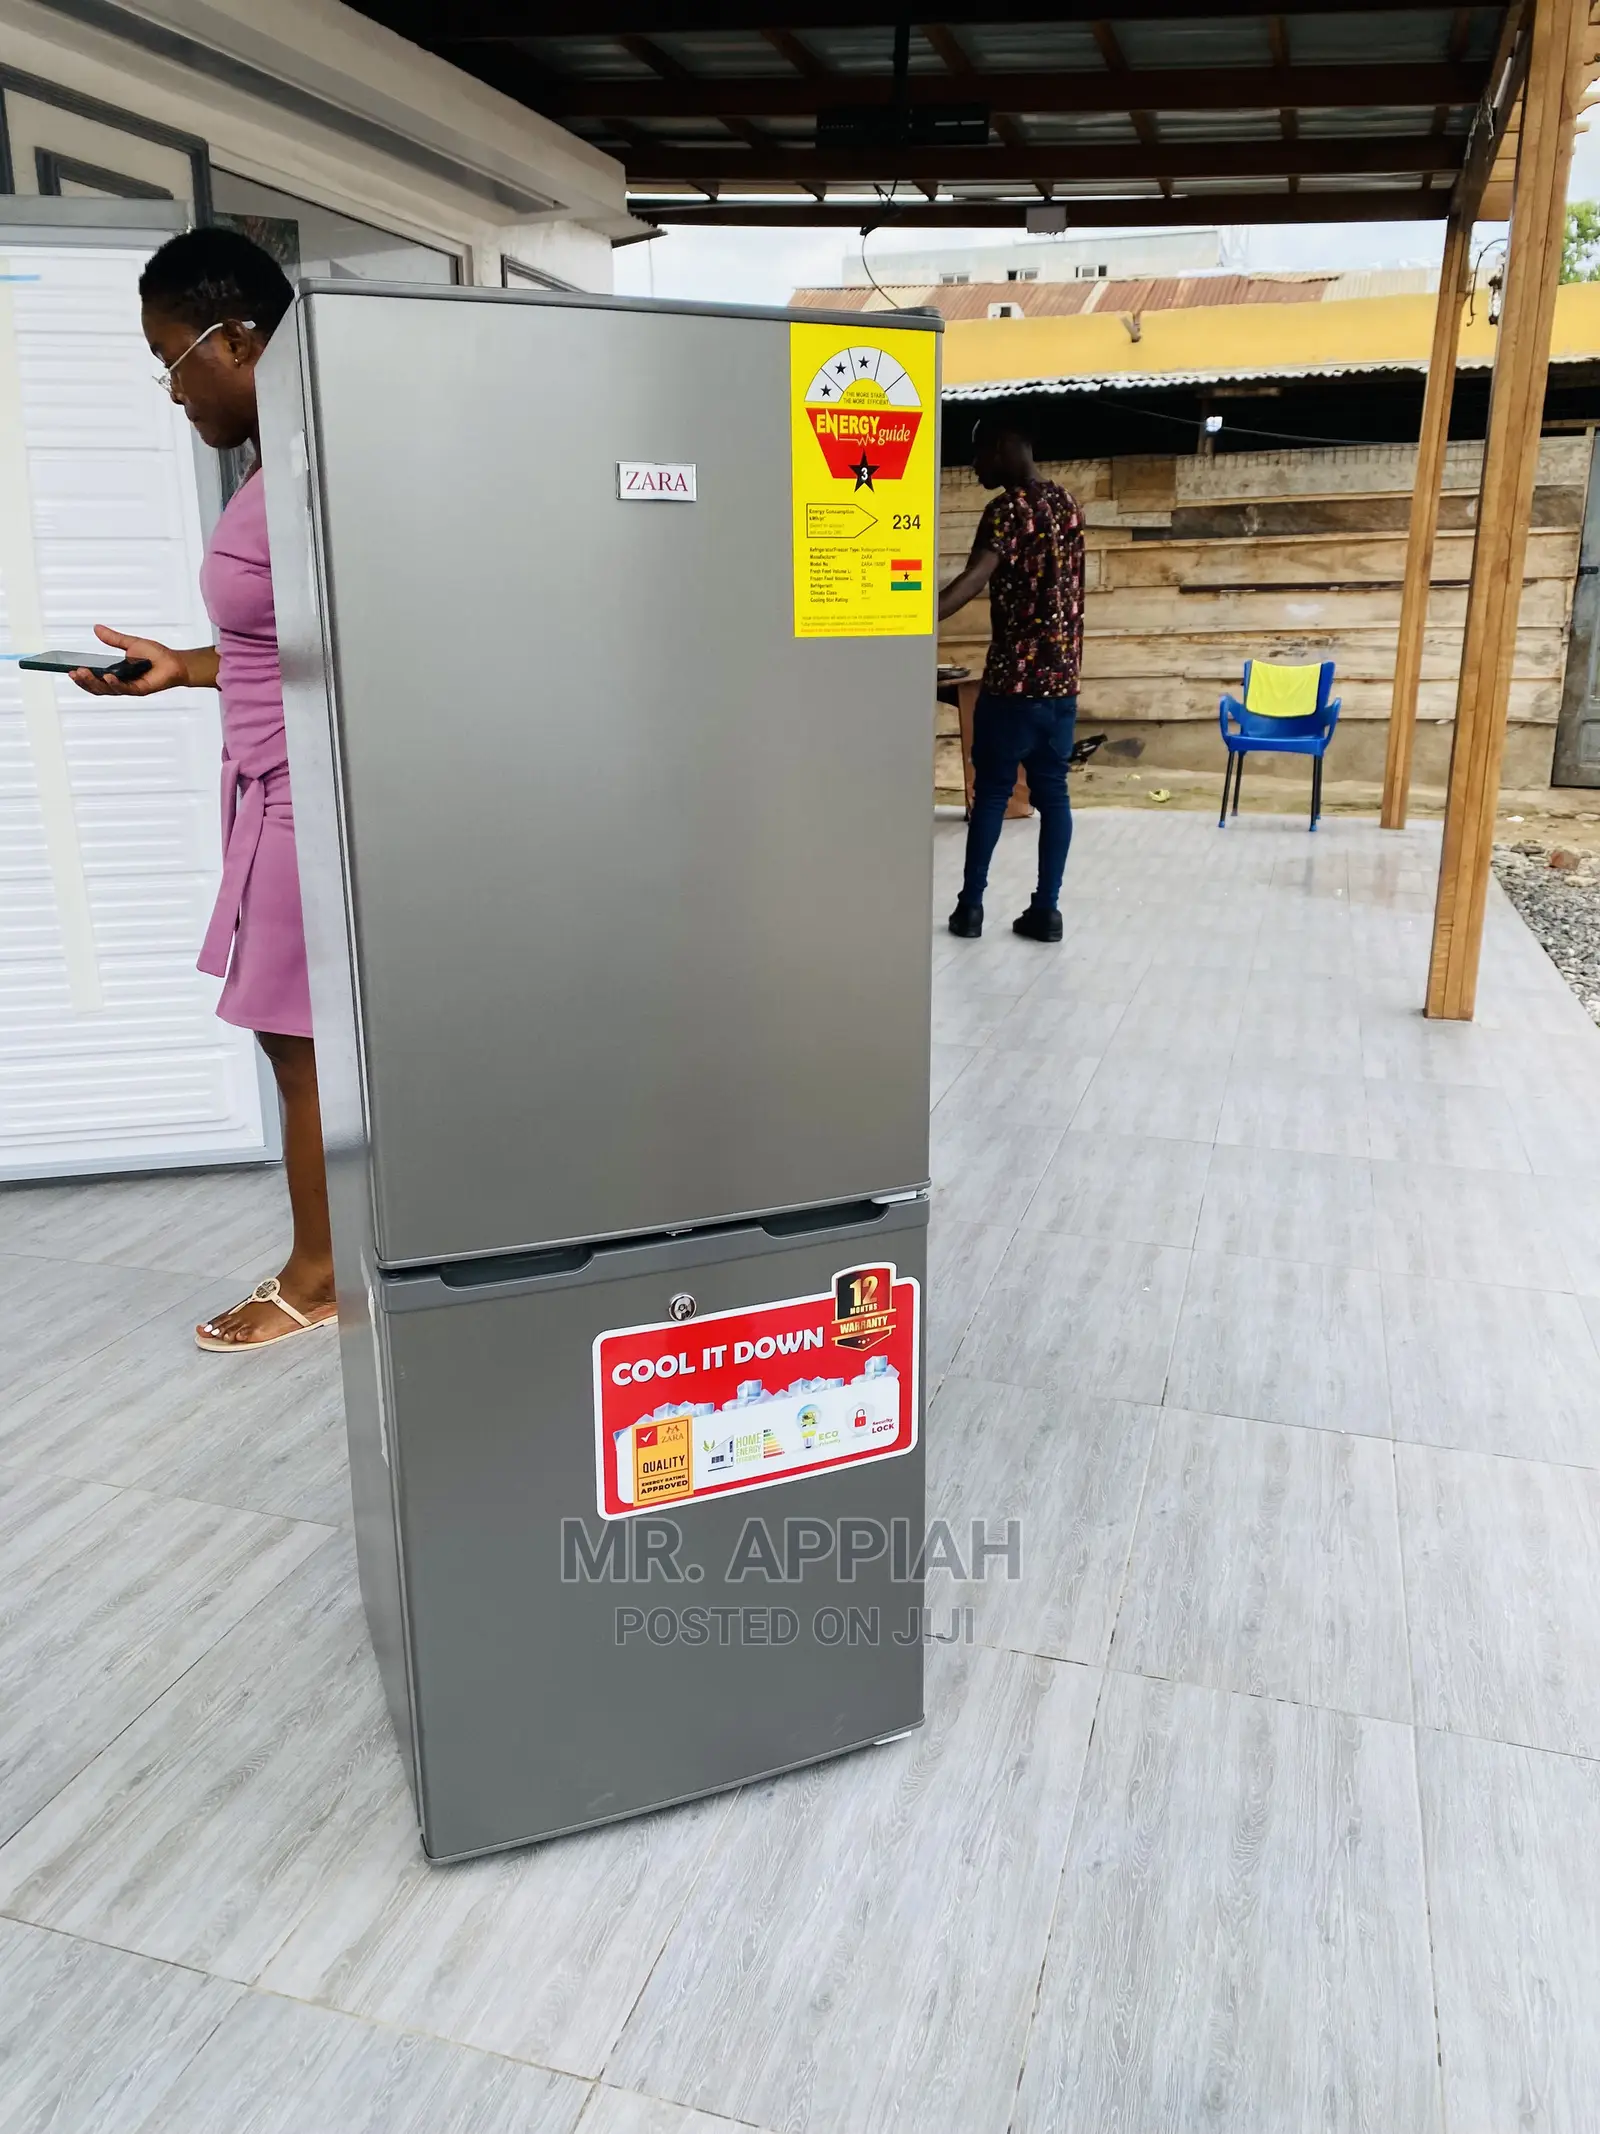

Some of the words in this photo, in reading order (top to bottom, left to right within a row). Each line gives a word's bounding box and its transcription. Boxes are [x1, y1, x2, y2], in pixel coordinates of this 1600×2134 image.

[816, 409, 880, 440] ENERGY
[877, 424, 910, 446] guide
[626, 471, 688, 492] ZARA
[861, 467, 868, 480] 3
[892, 514, 921, 530] 234
[849, 1275, 878, 1307] 12
[850, 1303, 878, 1315] MONTHS
[840, 1315, 888, 1334] WARRANTY
[611, 1352, 696, 1387] COOL
[702, 1344, 728, 1371] IT
[733, 1326, 824, 1365] DOWN
[871, 1423, 895, 1434] LOCK
[872, 1417, 893, 1426] Security
[661, 1432, 684, 1444] ZARA
[736, 1432, 762, 1449] HOME
[818, 1430, 839, 1441] ECO
[736, 1445, 761, 1458] ENERGY
[642, 1454, 686, 1474] QUALITY
[640, 1479, 689, 1495] APPROVED
[641, 1478, 664, 1487] ENERGY
[665, 1474, 686, 1482] RATING
